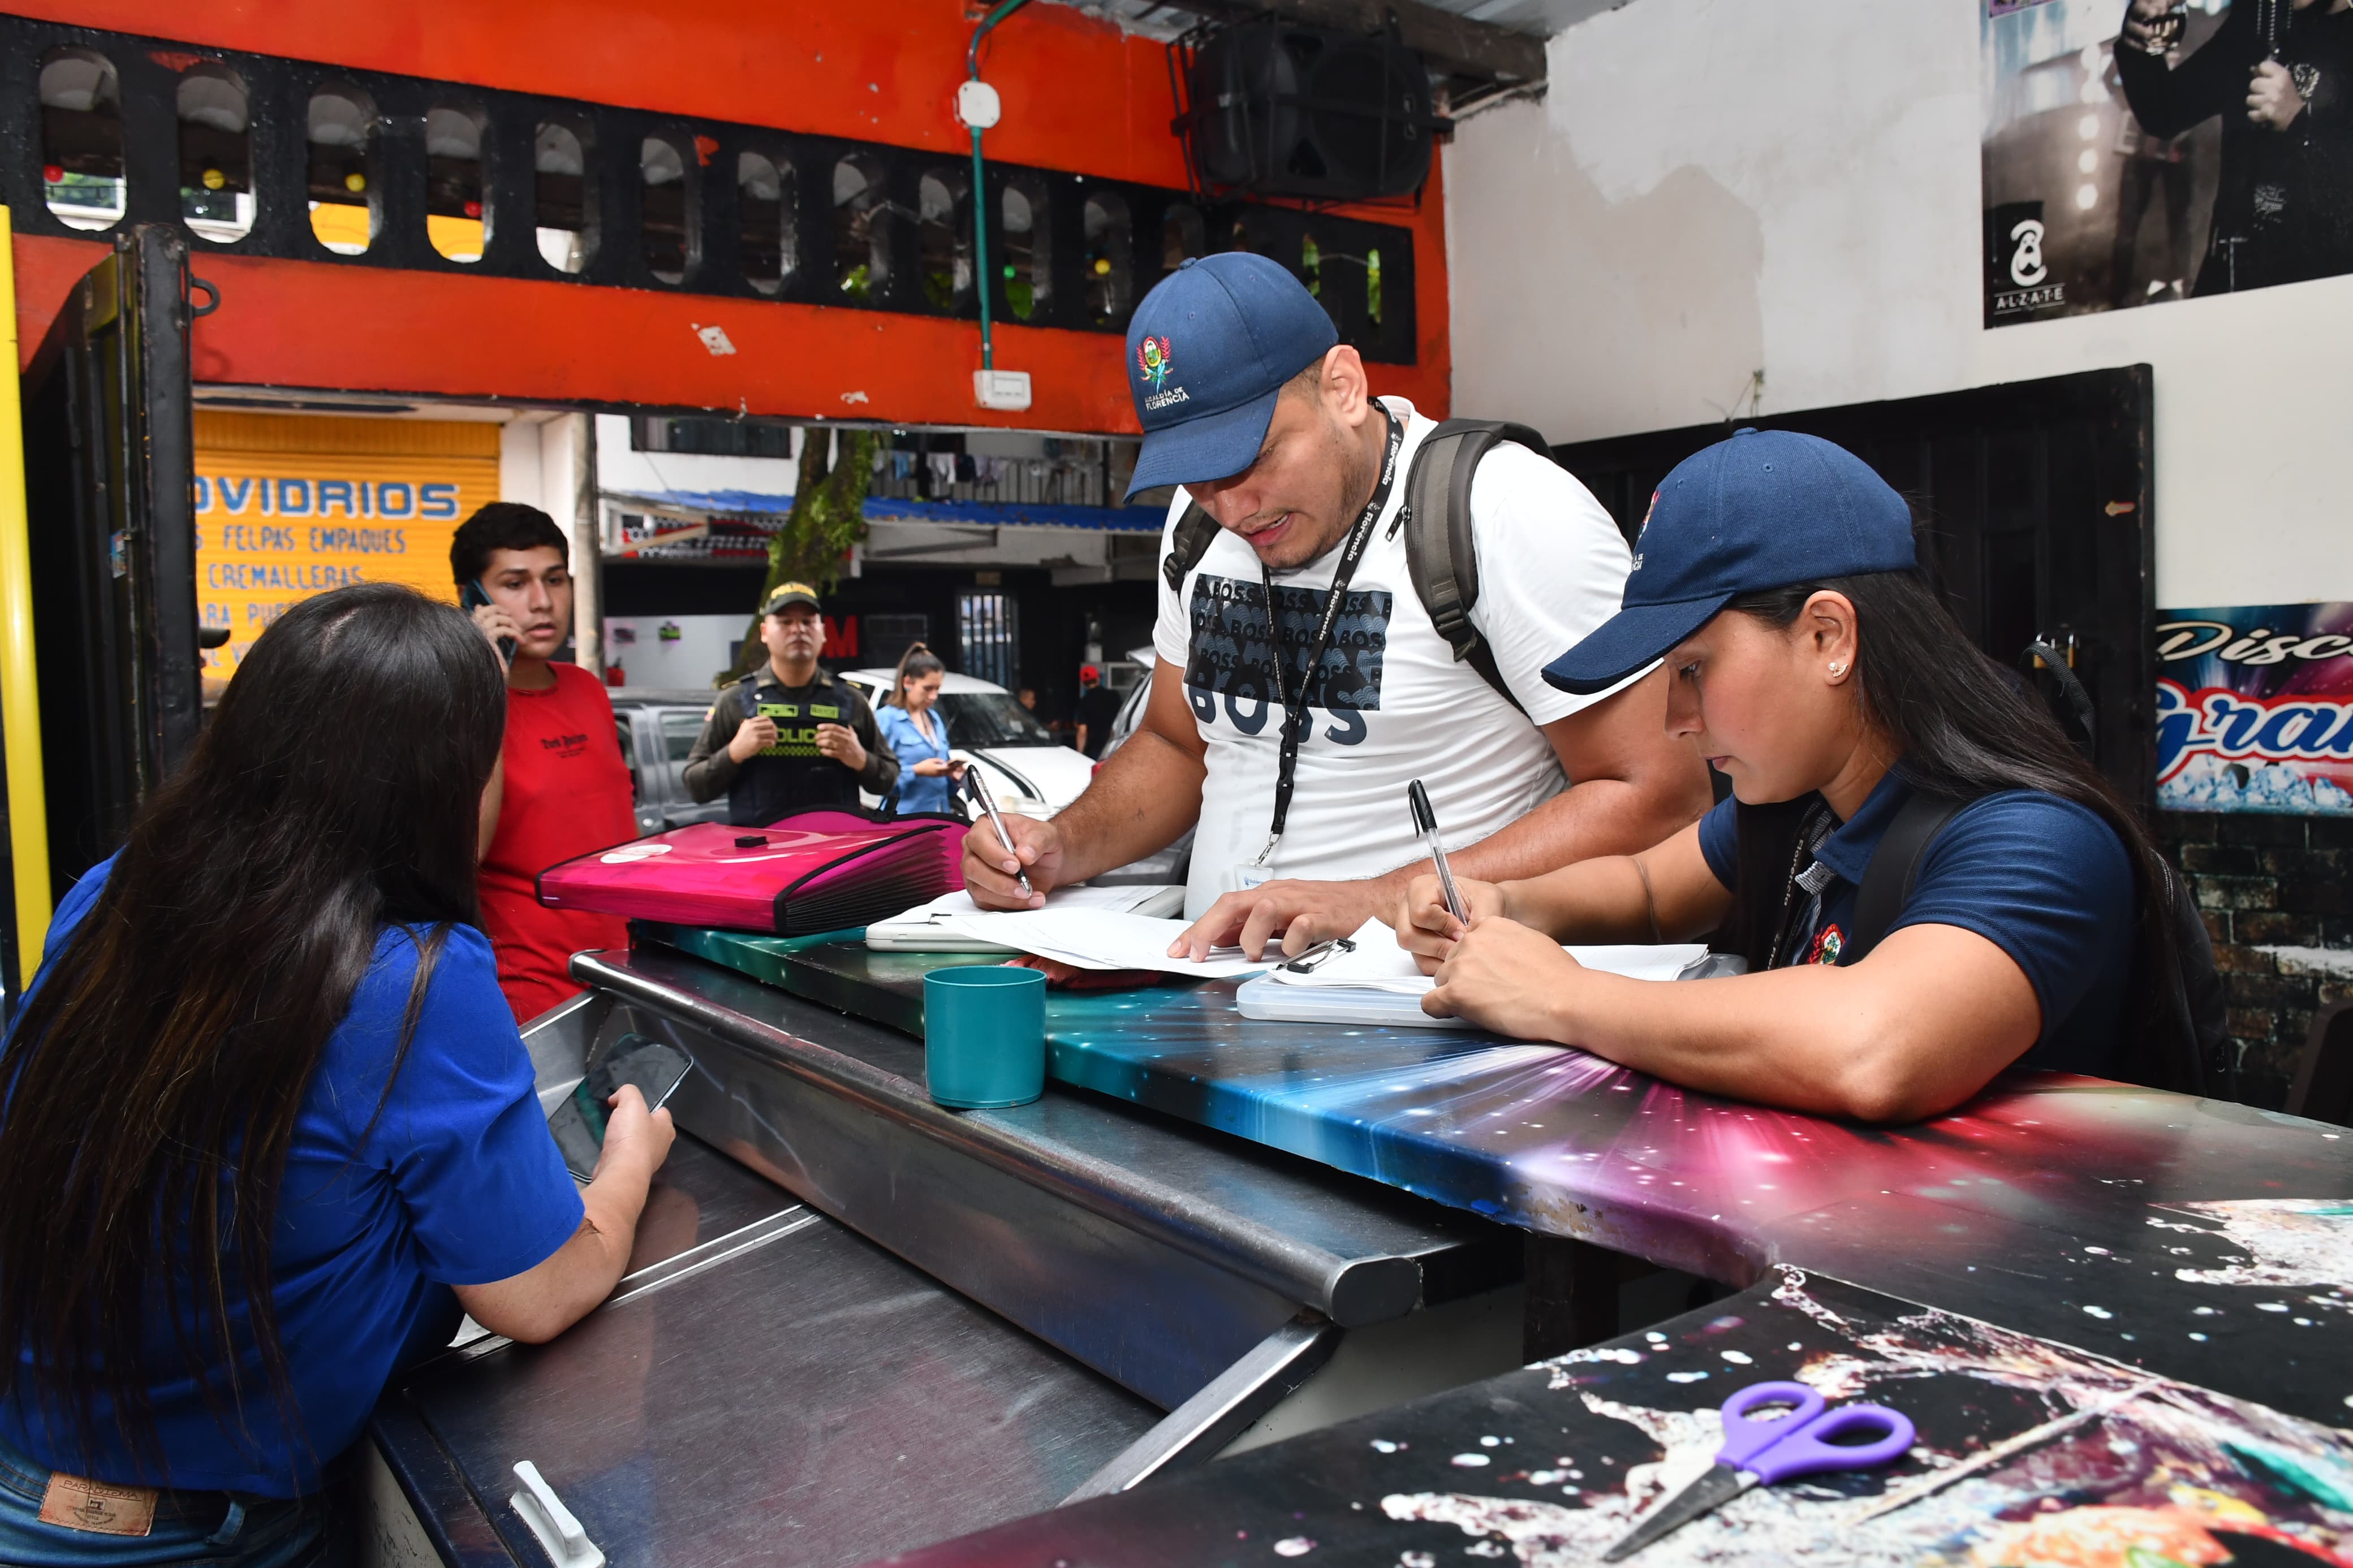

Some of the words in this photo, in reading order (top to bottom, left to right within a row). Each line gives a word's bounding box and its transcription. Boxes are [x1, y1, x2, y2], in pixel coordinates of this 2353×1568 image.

[1996, 287, 2063, 309] ALZATE
[1146, 391, 1190, 412] FLORENCIA
[1382, 440, 1399, 486] Florencia
[223, 525, 295, 551] FELPAS
[309, 528, 406, 554] EMPAQUES
[1347, 511, 1374, 561] Florencia
[208, 564, 364, 590] CREMALLERAS
[1319, 589, 1341, 641] Florencia
[1339, 630, 1385, 647] BOS
[2156, 621, 2353, 665] Disc
[1784, 839, 1804, 906] Florencia
